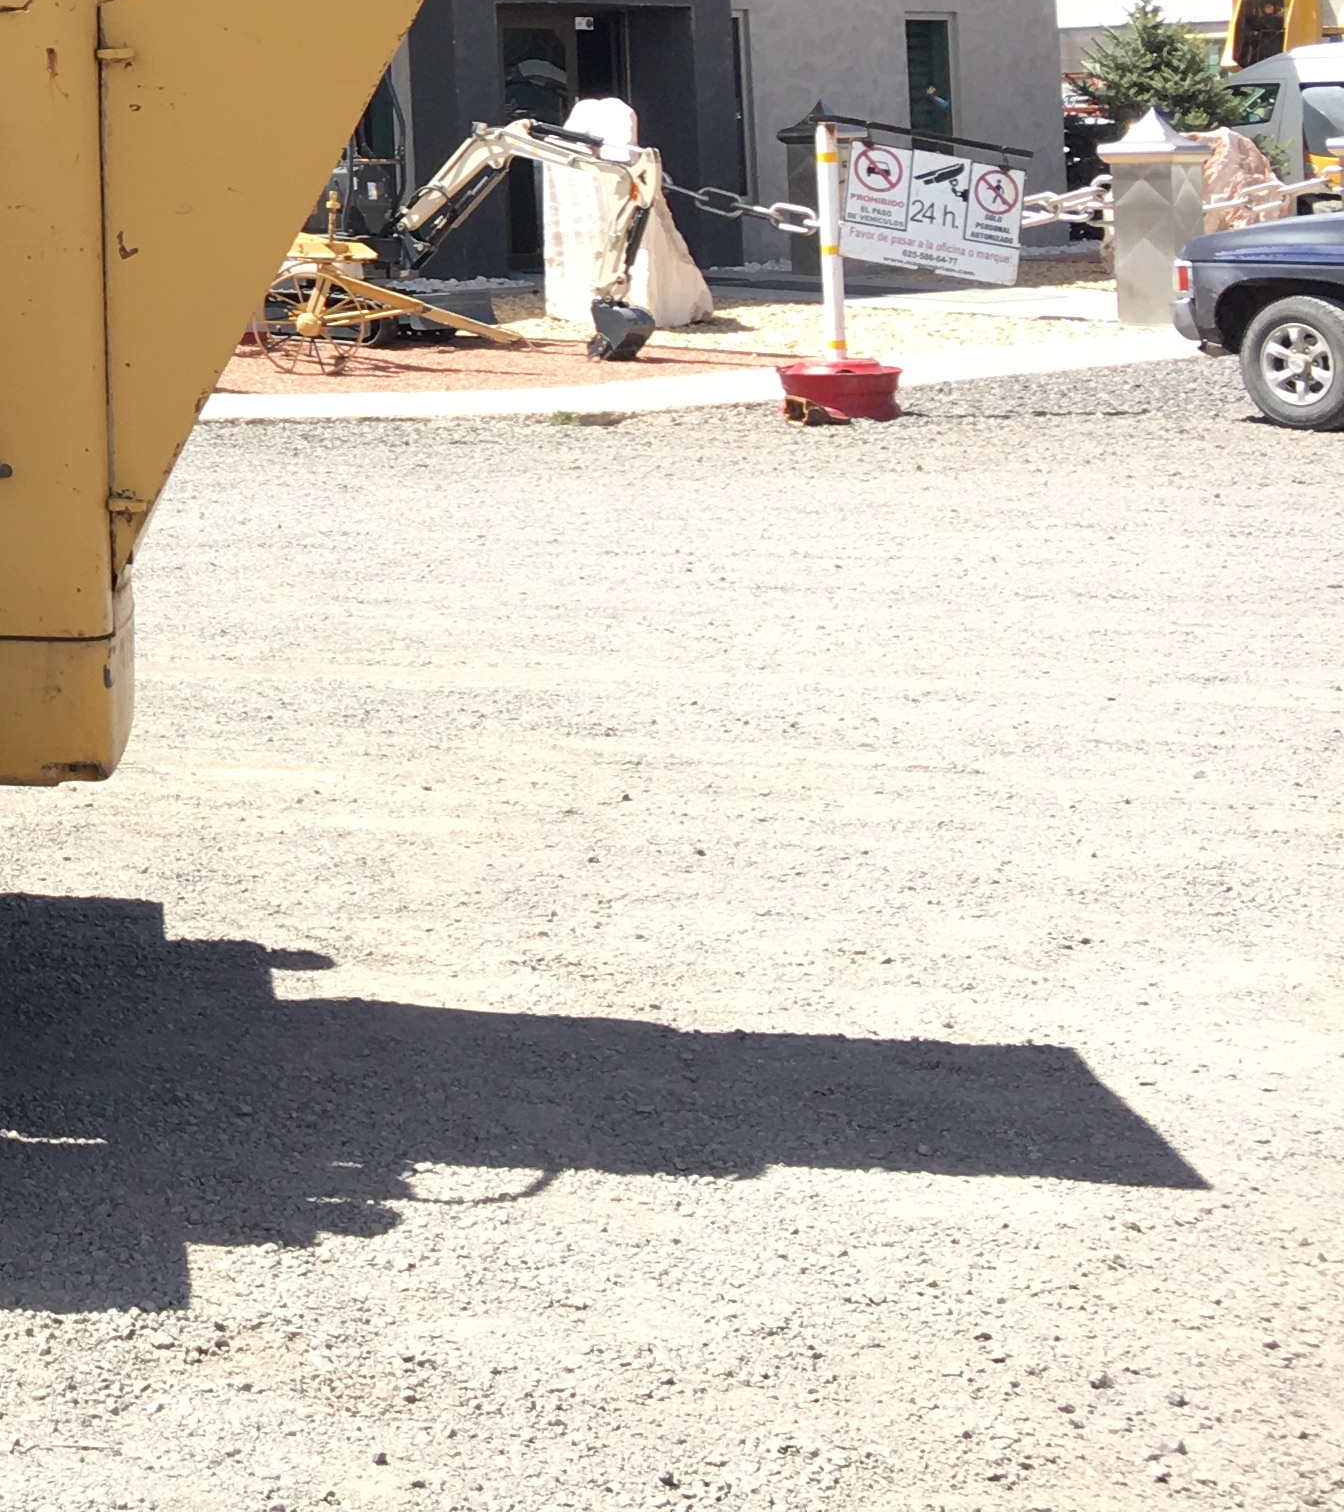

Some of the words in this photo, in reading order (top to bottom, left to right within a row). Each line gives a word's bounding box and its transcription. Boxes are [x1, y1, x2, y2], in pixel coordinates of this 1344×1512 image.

[850, 193, 905, 208] PROHIBIDO
[910, 199, 936, 224] 24
[849, 227, 875, 240] Favor
[878, 232, 888, 242] de
[890, 235, 916, 246] pasar
